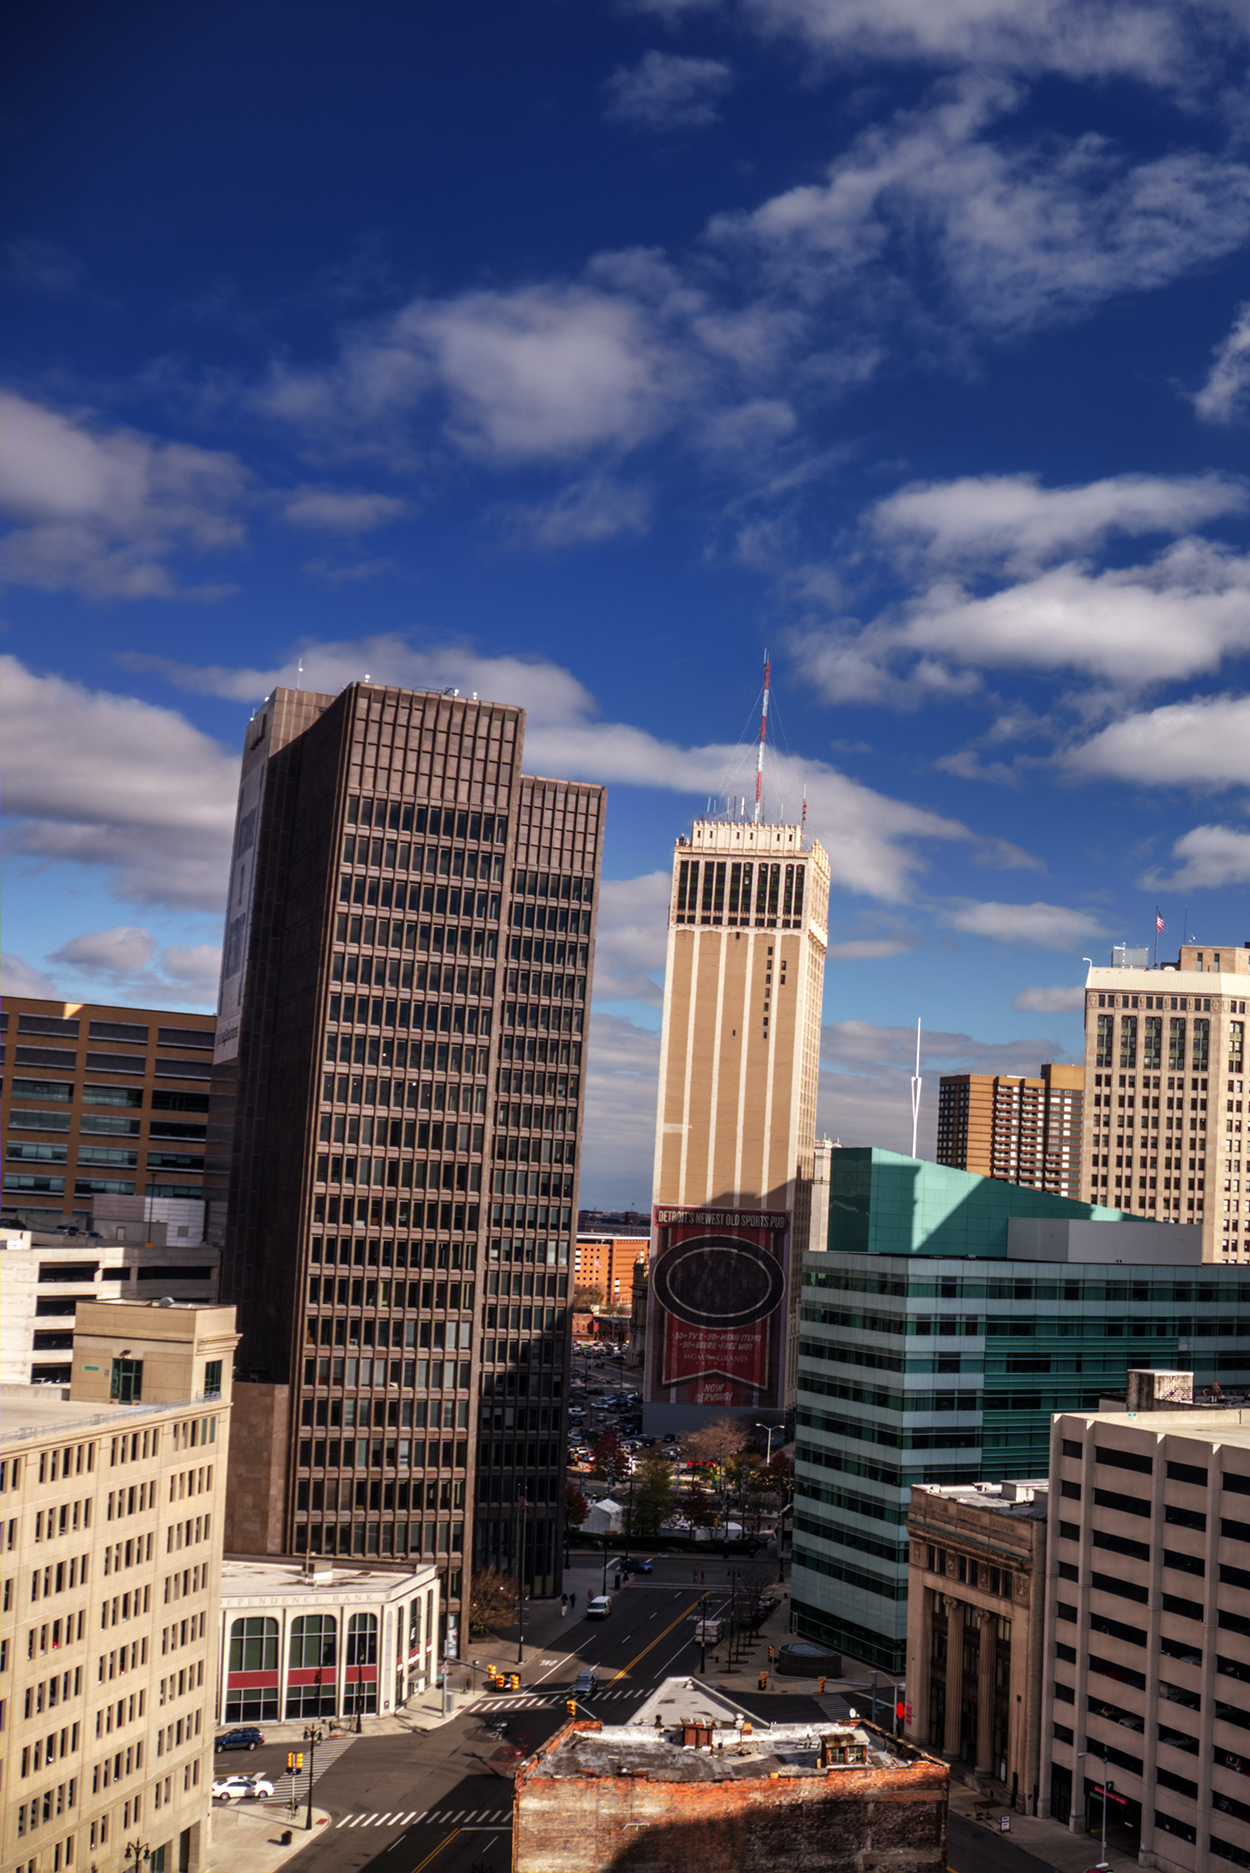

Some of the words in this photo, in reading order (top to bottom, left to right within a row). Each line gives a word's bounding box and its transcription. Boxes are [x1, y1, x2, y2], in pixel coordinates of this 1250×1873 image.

[658, 1210, 695, 1223] DETROIT'S
[695, 1213, 724, 1225] NEWEST
[725, 1214, 740, 1226] OLD
[741, 1215, 769, 1227] SPORTS
[770, 1216, 785, 1228] PUB
[720, 1333, 739, 1341] MENU
[740, 1334, 762, 1342] ITEMS
[695, 1341, 716, 1349] BEERS
[720, 1342, 736, 1350] FREE
[717, 1354, 748, 1362] GRAND
[704, 1384, 724, 1392] NOW
[694, 1392, 733, 1402] SERVING!
[332, 1593, 374, 1603] BANK
